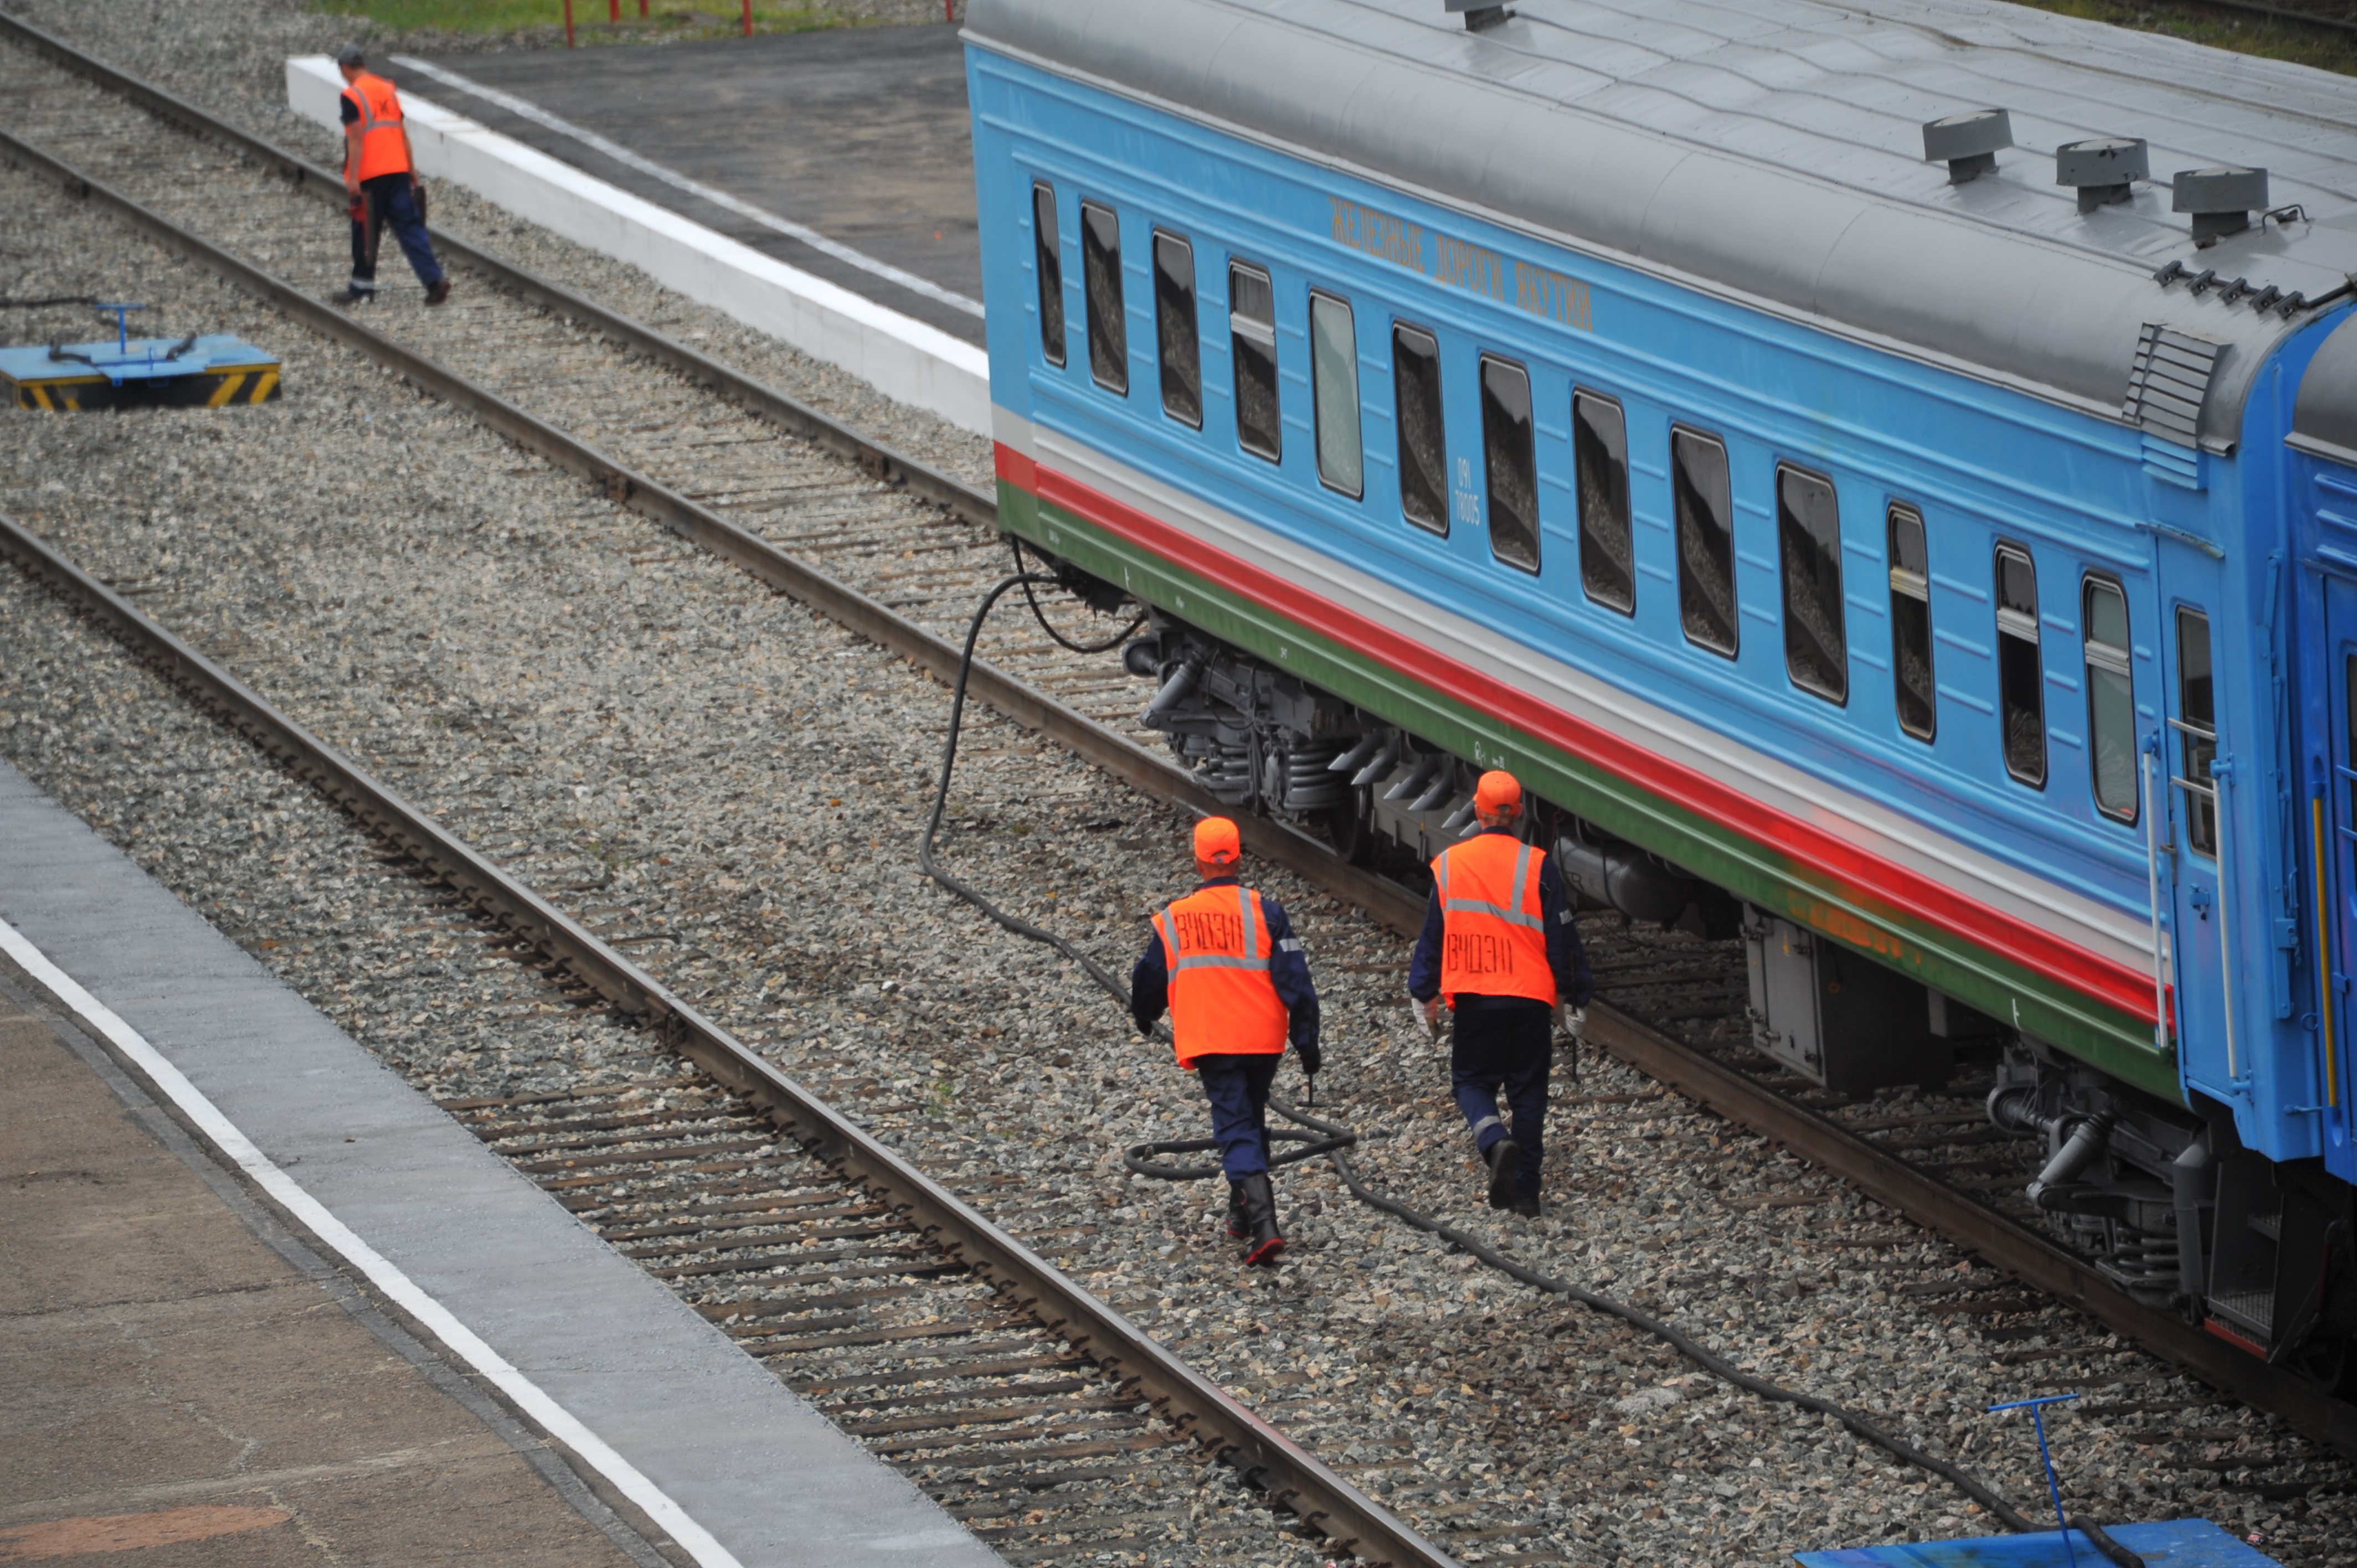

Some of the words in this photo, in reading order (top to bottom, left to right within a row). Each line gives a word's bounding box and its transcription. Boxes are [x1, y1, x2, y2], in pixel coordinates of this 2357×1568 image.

[1329, 194, 1425, 274] ЖЕЛЕЗНЫЕ
[1431, 234, 1504, 290] ДОРОГИ
[1515, 261, 1593, 332] ЯКУТИИ
[1457, 457, 1471, 491] 091
